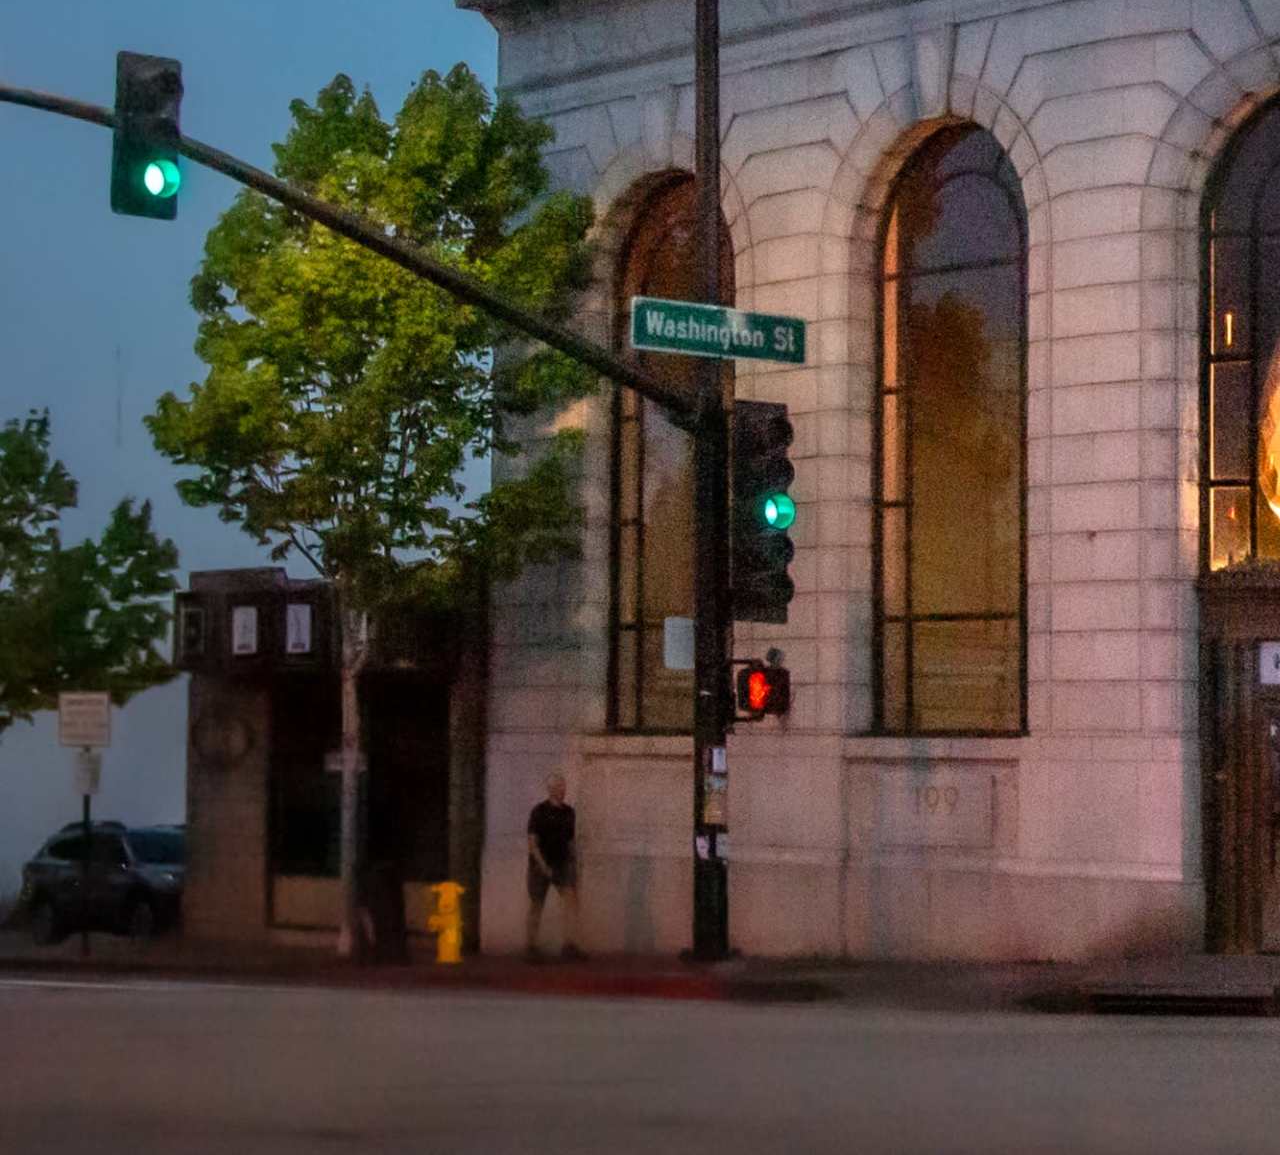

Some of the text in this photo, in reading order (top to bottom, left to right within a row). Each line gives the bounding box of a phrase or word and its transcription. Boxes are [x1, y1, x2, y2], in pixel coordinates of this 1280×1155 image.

[646, 309, 795, 353] Washington St
[912, 785, 960, 815] 199
